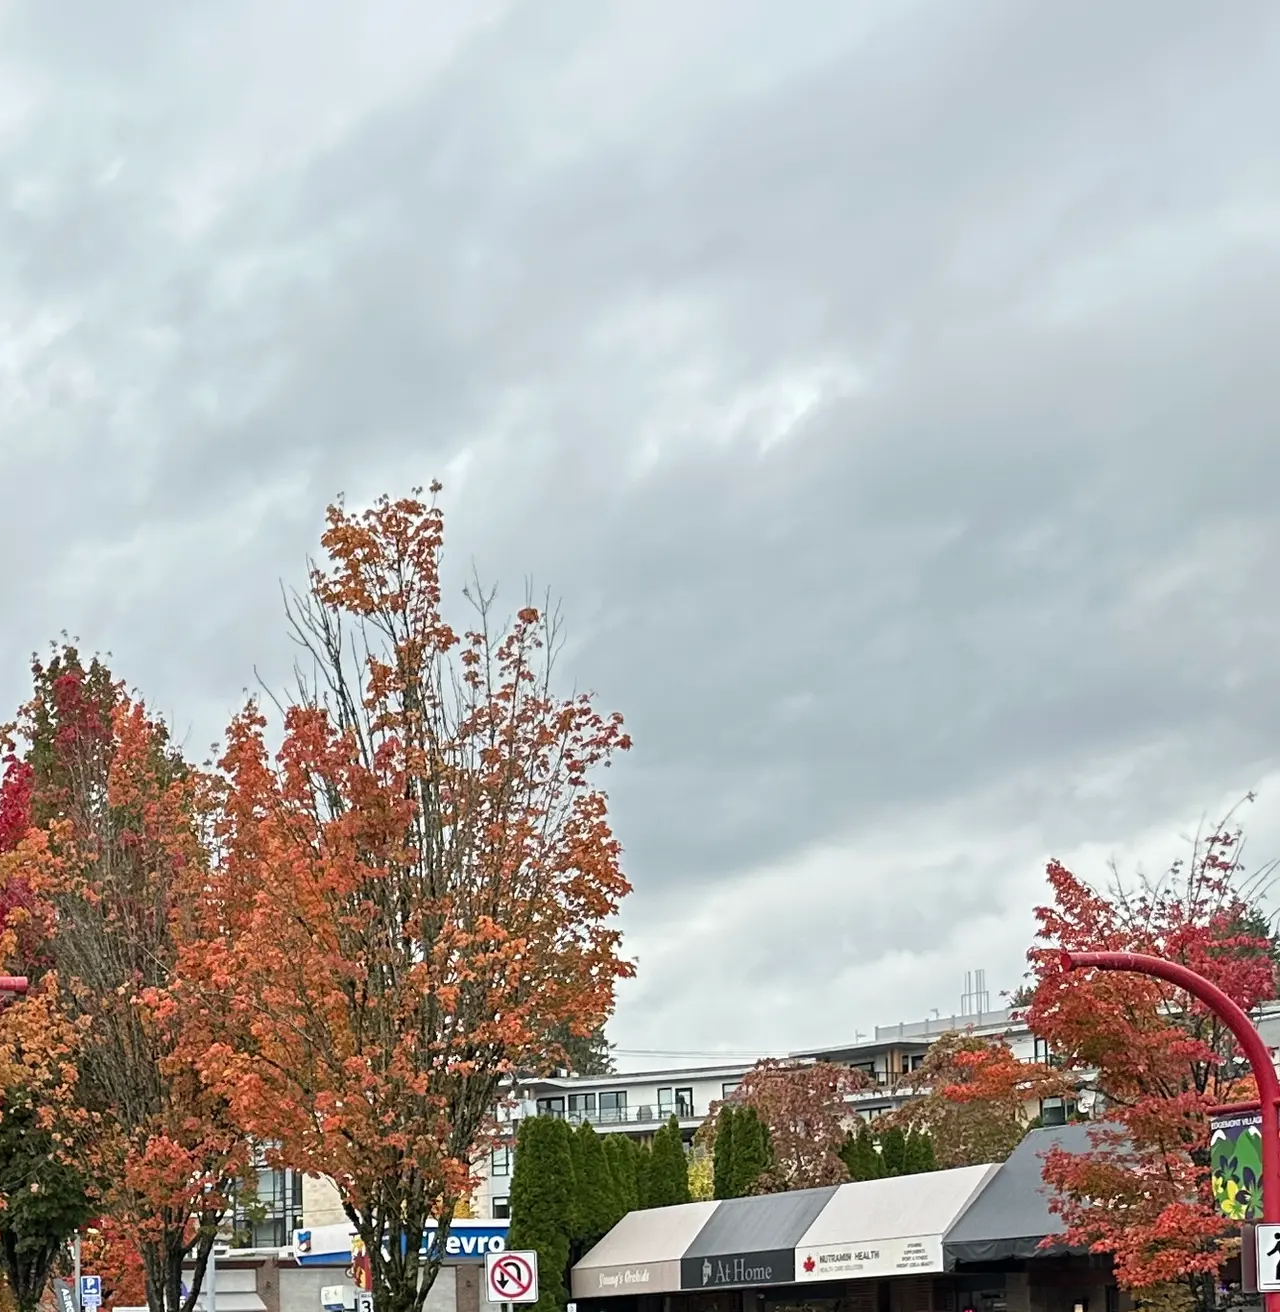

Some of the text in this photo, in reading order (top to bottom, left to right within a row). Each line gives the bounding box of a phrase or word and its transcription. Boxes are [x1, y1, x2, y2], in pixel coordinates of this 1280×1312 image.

[1211, 1119, 1241, 1130] EDGEMONT
[418, 1231, 505, 1254] evro
[854, 1250, 880, 1261] HEALTH
[714, 1258, 772, 1284] At Home
